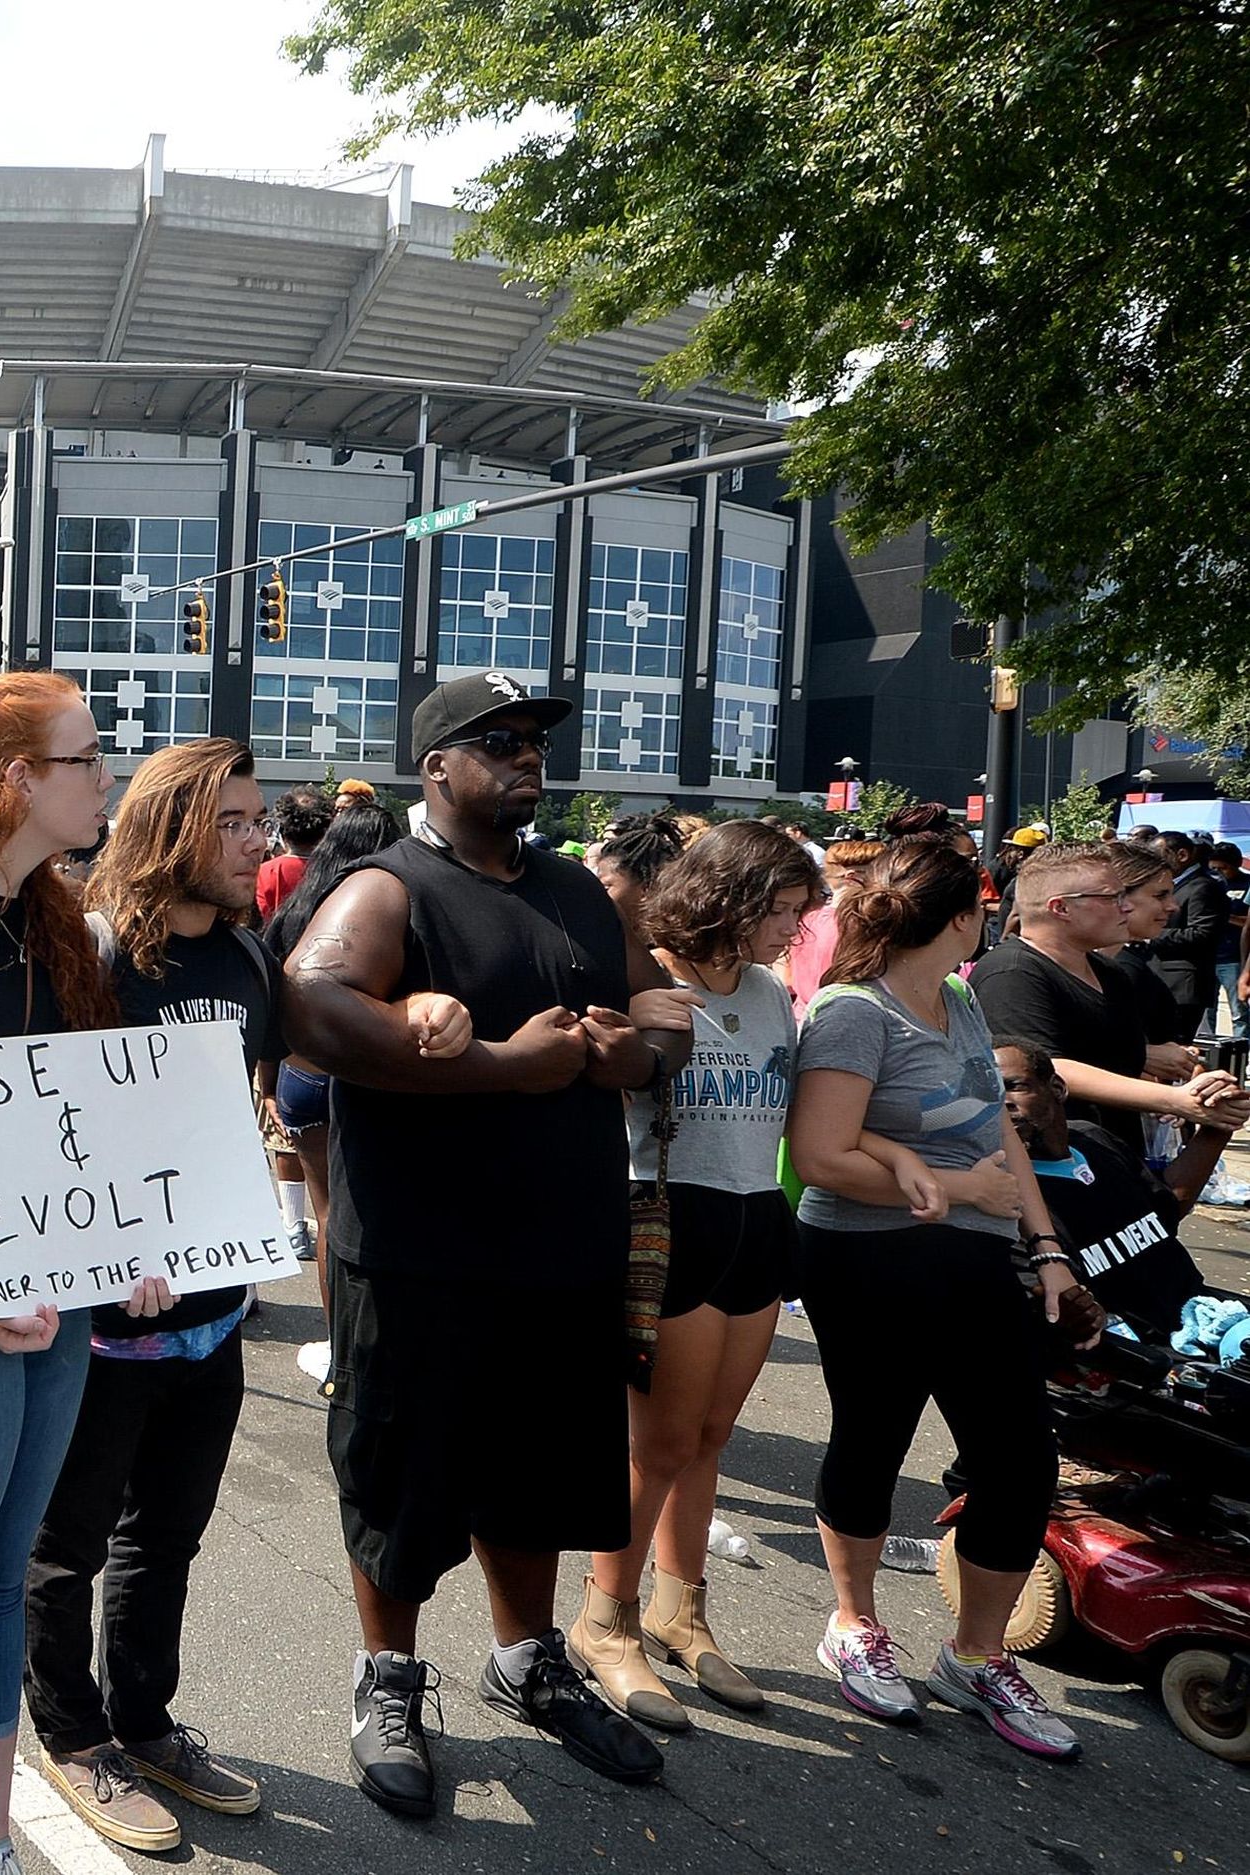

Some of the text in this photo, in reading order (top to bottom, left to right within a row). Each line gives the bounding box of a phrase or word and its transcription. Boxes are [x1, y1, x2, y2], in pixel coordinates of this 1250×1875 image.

[434, 508, 461, 529] MINT
[158, 998, 248, 1029] ALL LIVES MATTER
[101, 1032, 168, 1085] UP
[689, 1052, 751, 1067] FERENCE
[58, 1101, 90, 1171] &
[655, 1111, 738, 1121] CROLINA
[1104, 1237, 1126, 1264] I
[1116, 1211, 1169, 1258] NEXT
[46, 1270, 75, 1295] TO
[87, 1256, 141, 1292] THE
[164, 1237, 285, 1279] PEOPLE
